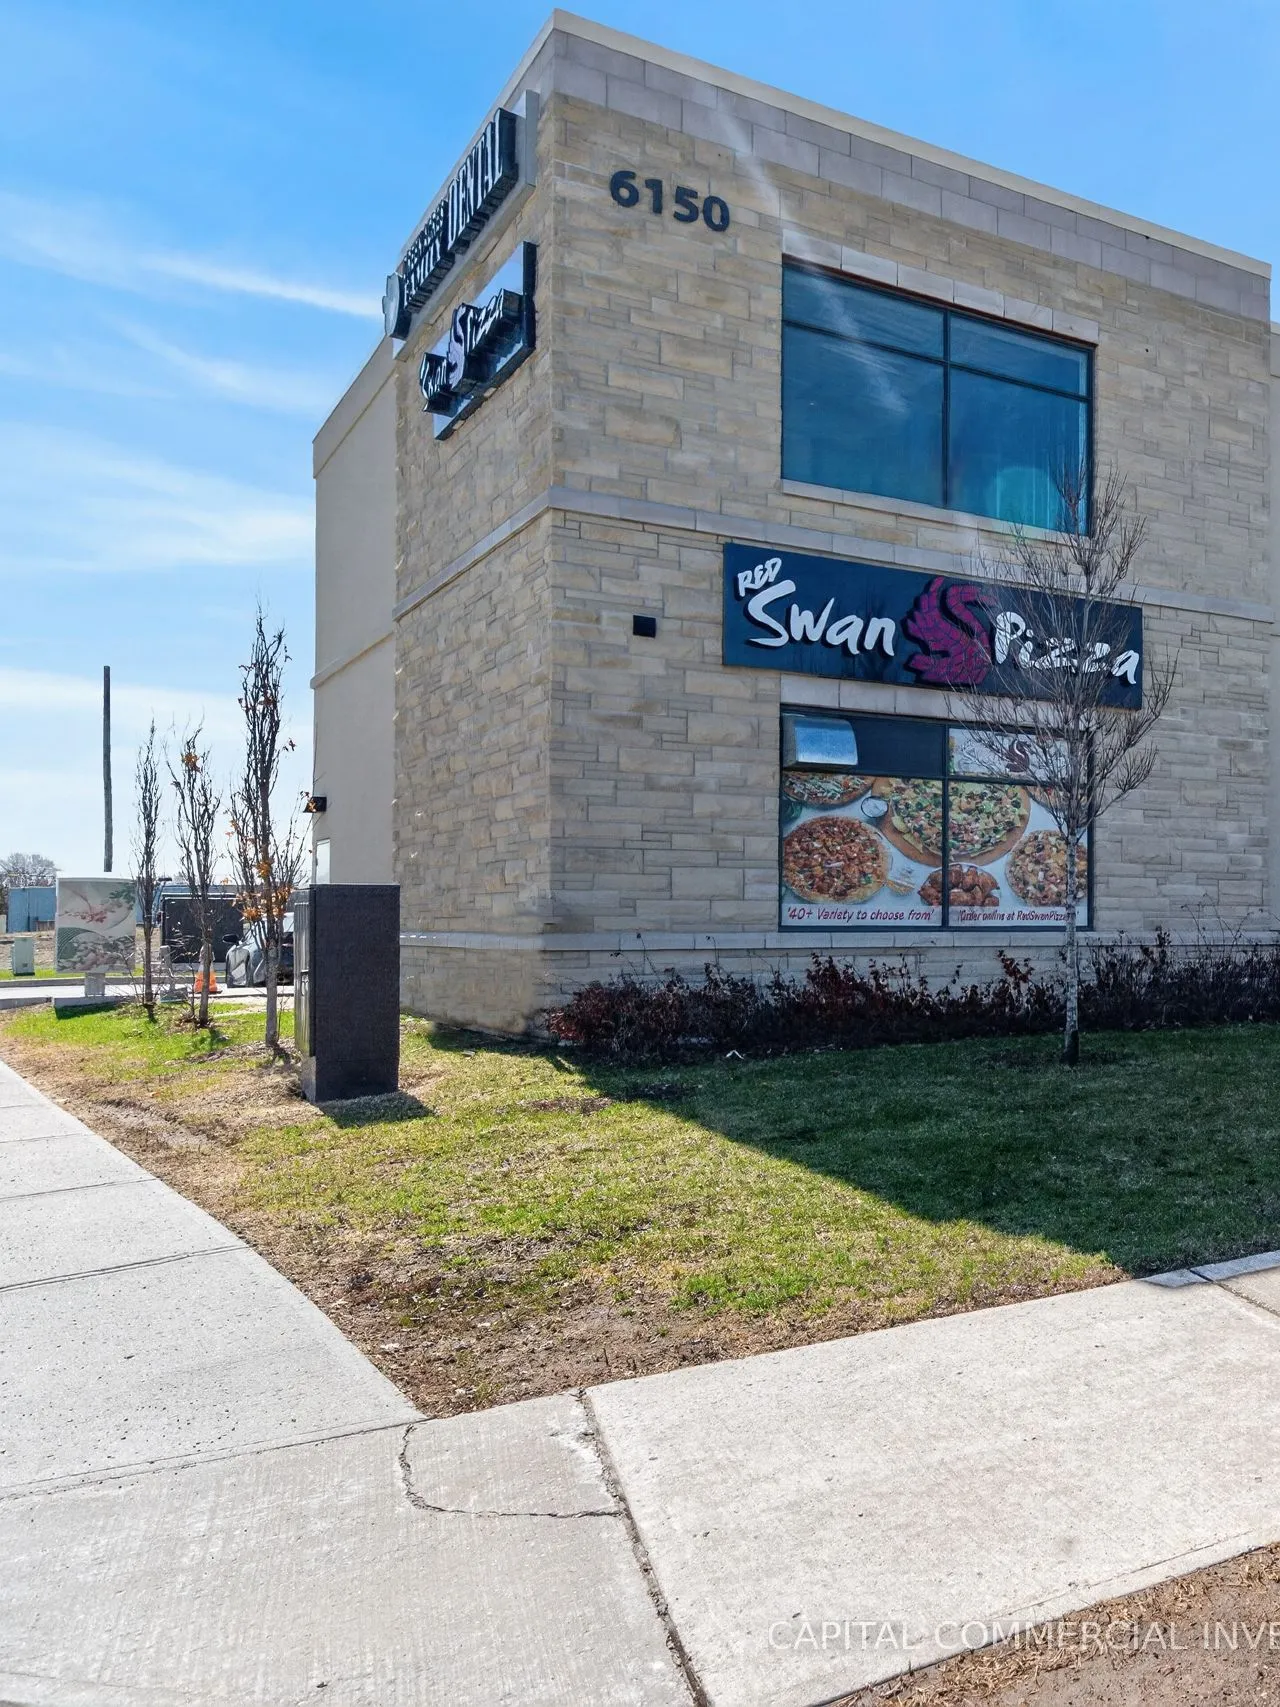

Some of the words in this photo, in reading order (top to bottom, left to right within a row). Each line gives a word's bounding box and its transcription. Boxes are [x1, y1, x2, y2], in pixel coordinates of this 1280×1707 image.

[447, 107, 503, 250] DENTAL
[609, 170, 730, 232] 6150
[737, 557, 782, 597] RED
[748, 579, 896, 657] Swan
[995, 611, 1140, 685] Pizza
[817, 907, 852, 923] Variety
[856, 909, 867, 921] to
[870, 909, 905, 921] choose
